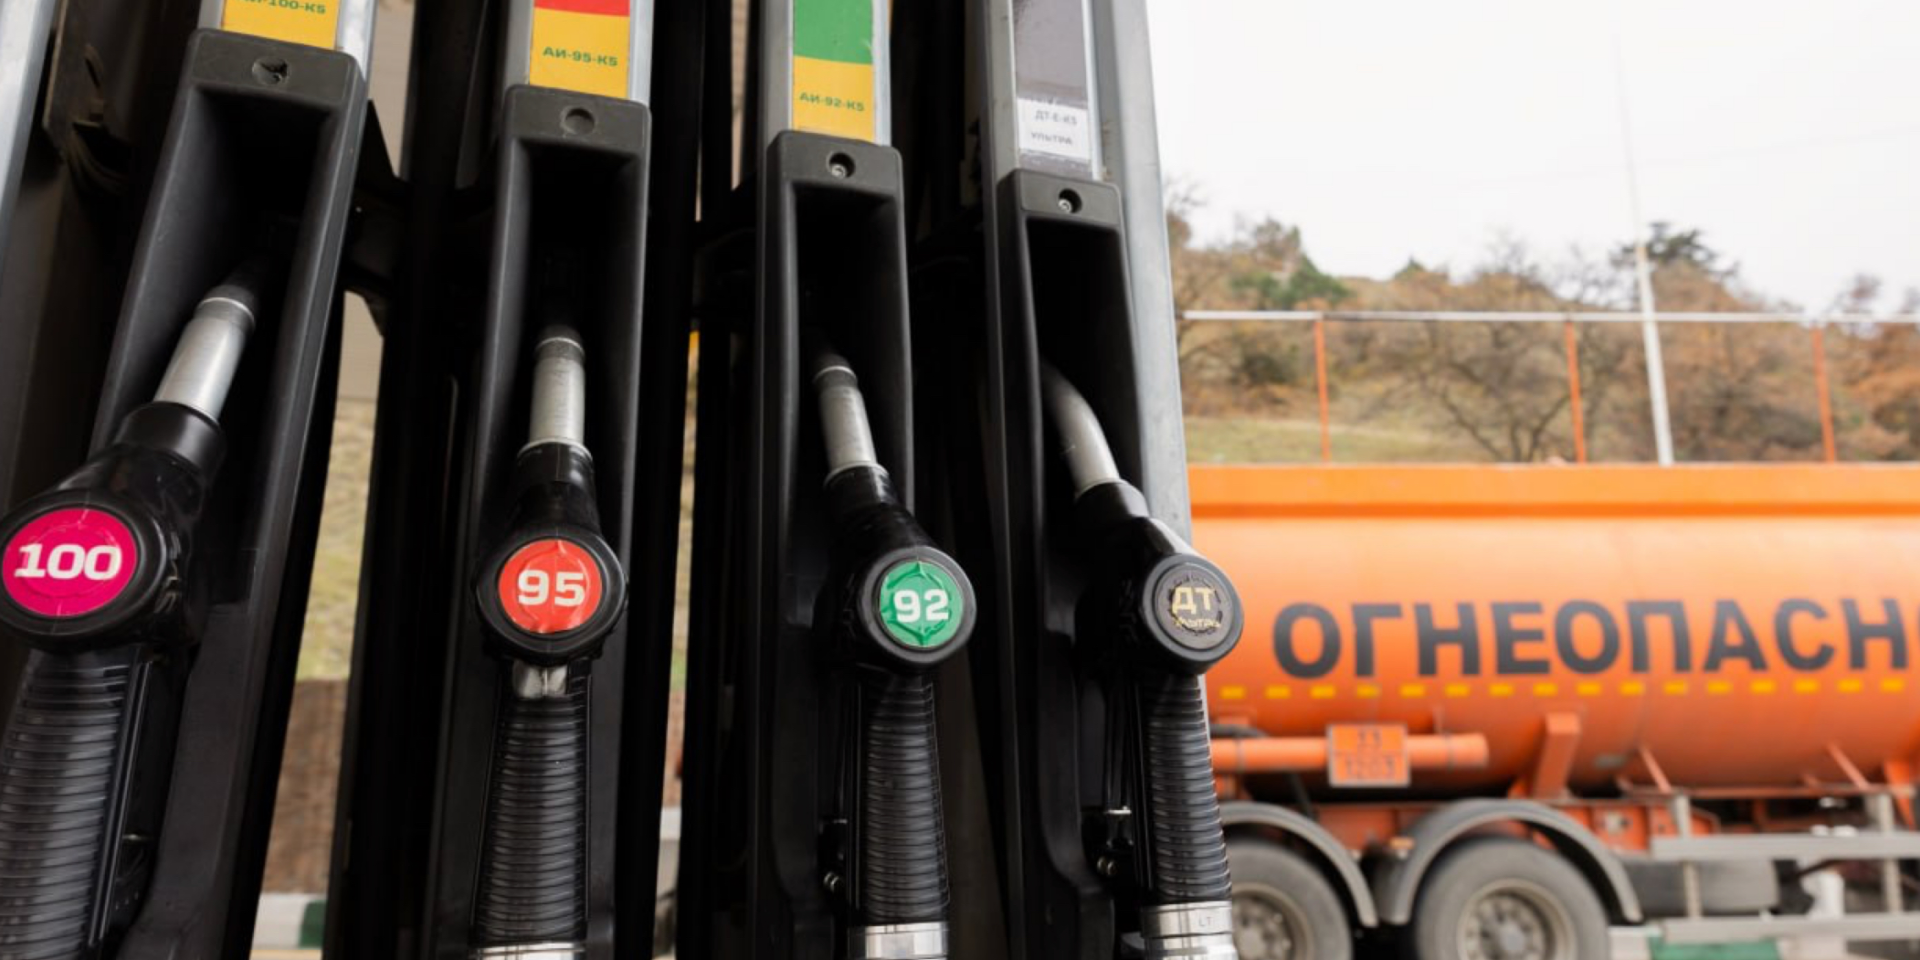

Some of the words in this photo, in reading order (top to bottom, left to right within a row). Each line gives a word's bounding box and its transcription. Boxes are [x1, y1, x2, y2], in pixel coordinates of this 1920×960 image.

[240, 0, 326, 14] -100-К5
[543, 46, 618, 67] АИ-95-К5
[799, 92, 864, 111] АИ-92-К5
[14, 543, 122, 580] 100
[518, 569, 585, 607] 95
[1172, 587, 1214, 615] ДТ
[893, 589, 949, 622] 92
[1272, 598, 1920, 679] ОГНЕОПАСН
